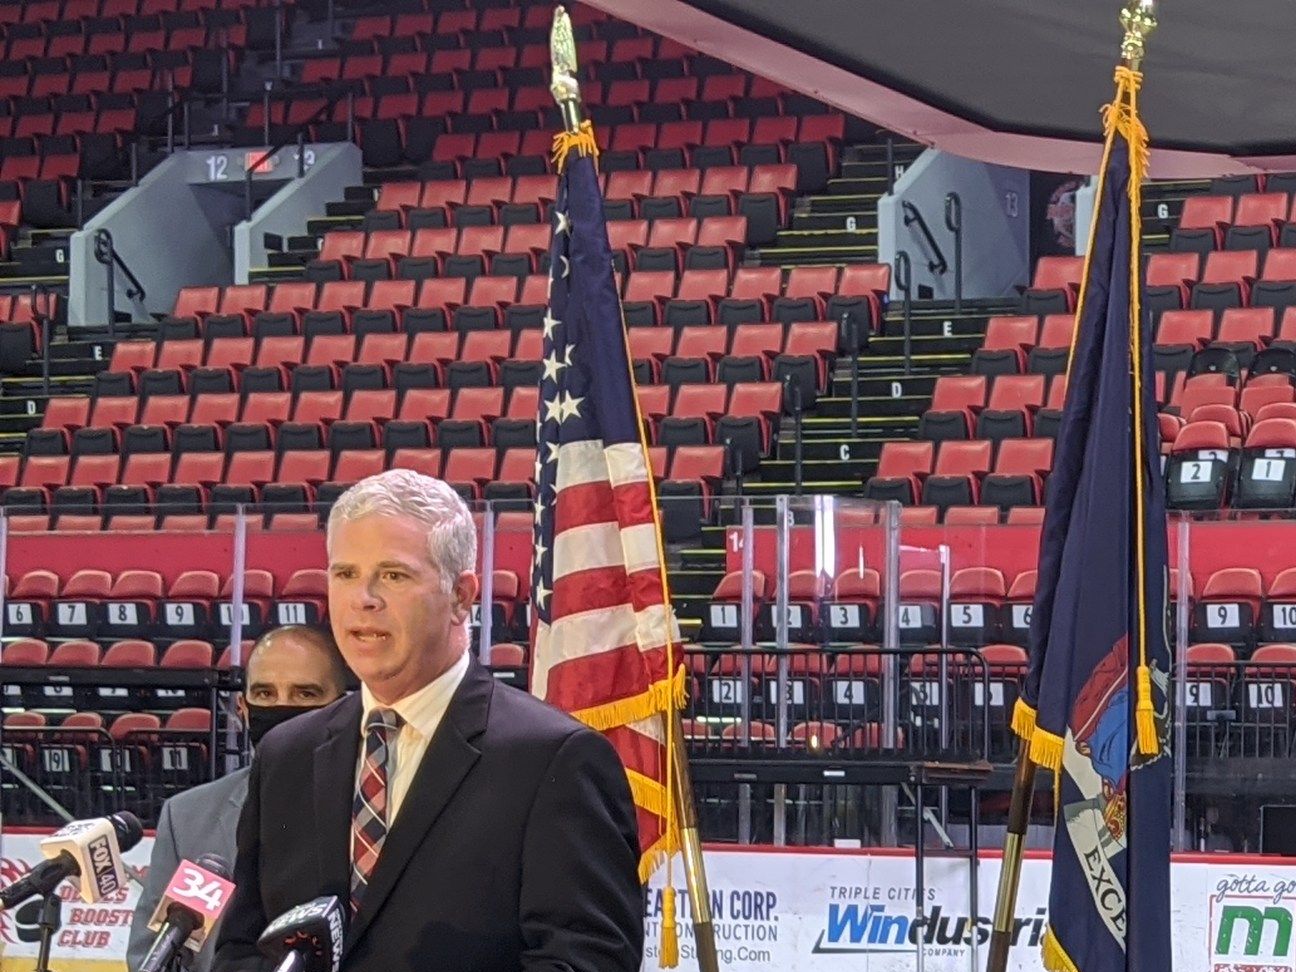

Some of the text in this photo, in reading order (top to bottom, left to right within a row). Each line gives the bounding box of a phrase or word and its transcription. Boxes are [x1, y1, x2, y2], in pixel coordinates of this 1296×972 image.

[206, 155, 228, 180] 12
[1158, 204, 1168, 219] G
[846, 216, 856, 232] G
[55, 249, 65, 263] G
[943, 322, 952, 337] E
[94, 345, 103, 360] E
[891, 383, 902, 399] D
[27, 401, 36, 416] D
[840, 444, 850, 460] C
[1191, 464, 1201, 480] 2
[16, 605, 23, 622] 6
[67, 605, 76, 621] 7
[118, 605, 128, 621] 8
[175, 605, 184, 622] 9
[285, 605, 299, 622] 11
[839, 607, 849, 625] 3
[901, 607, 911, 626] 4
[962, 606, 972, 624] 5
[1218, 606, 1227, 625] 9
[723, 682, 733, 700] 2
[843, 683, 854, 700] 4
[1189, 685, 1199, 704] 9
[90, 835, 117, 895] FOX 40
[172, 868, 224, 912] 34
[830, 886, 880, 900] TRIPLE
[1216, 874, 1270, 903] gotta
[730, 891, 779, 921] CORP.
[58, 930, 111, 948] CLUB
